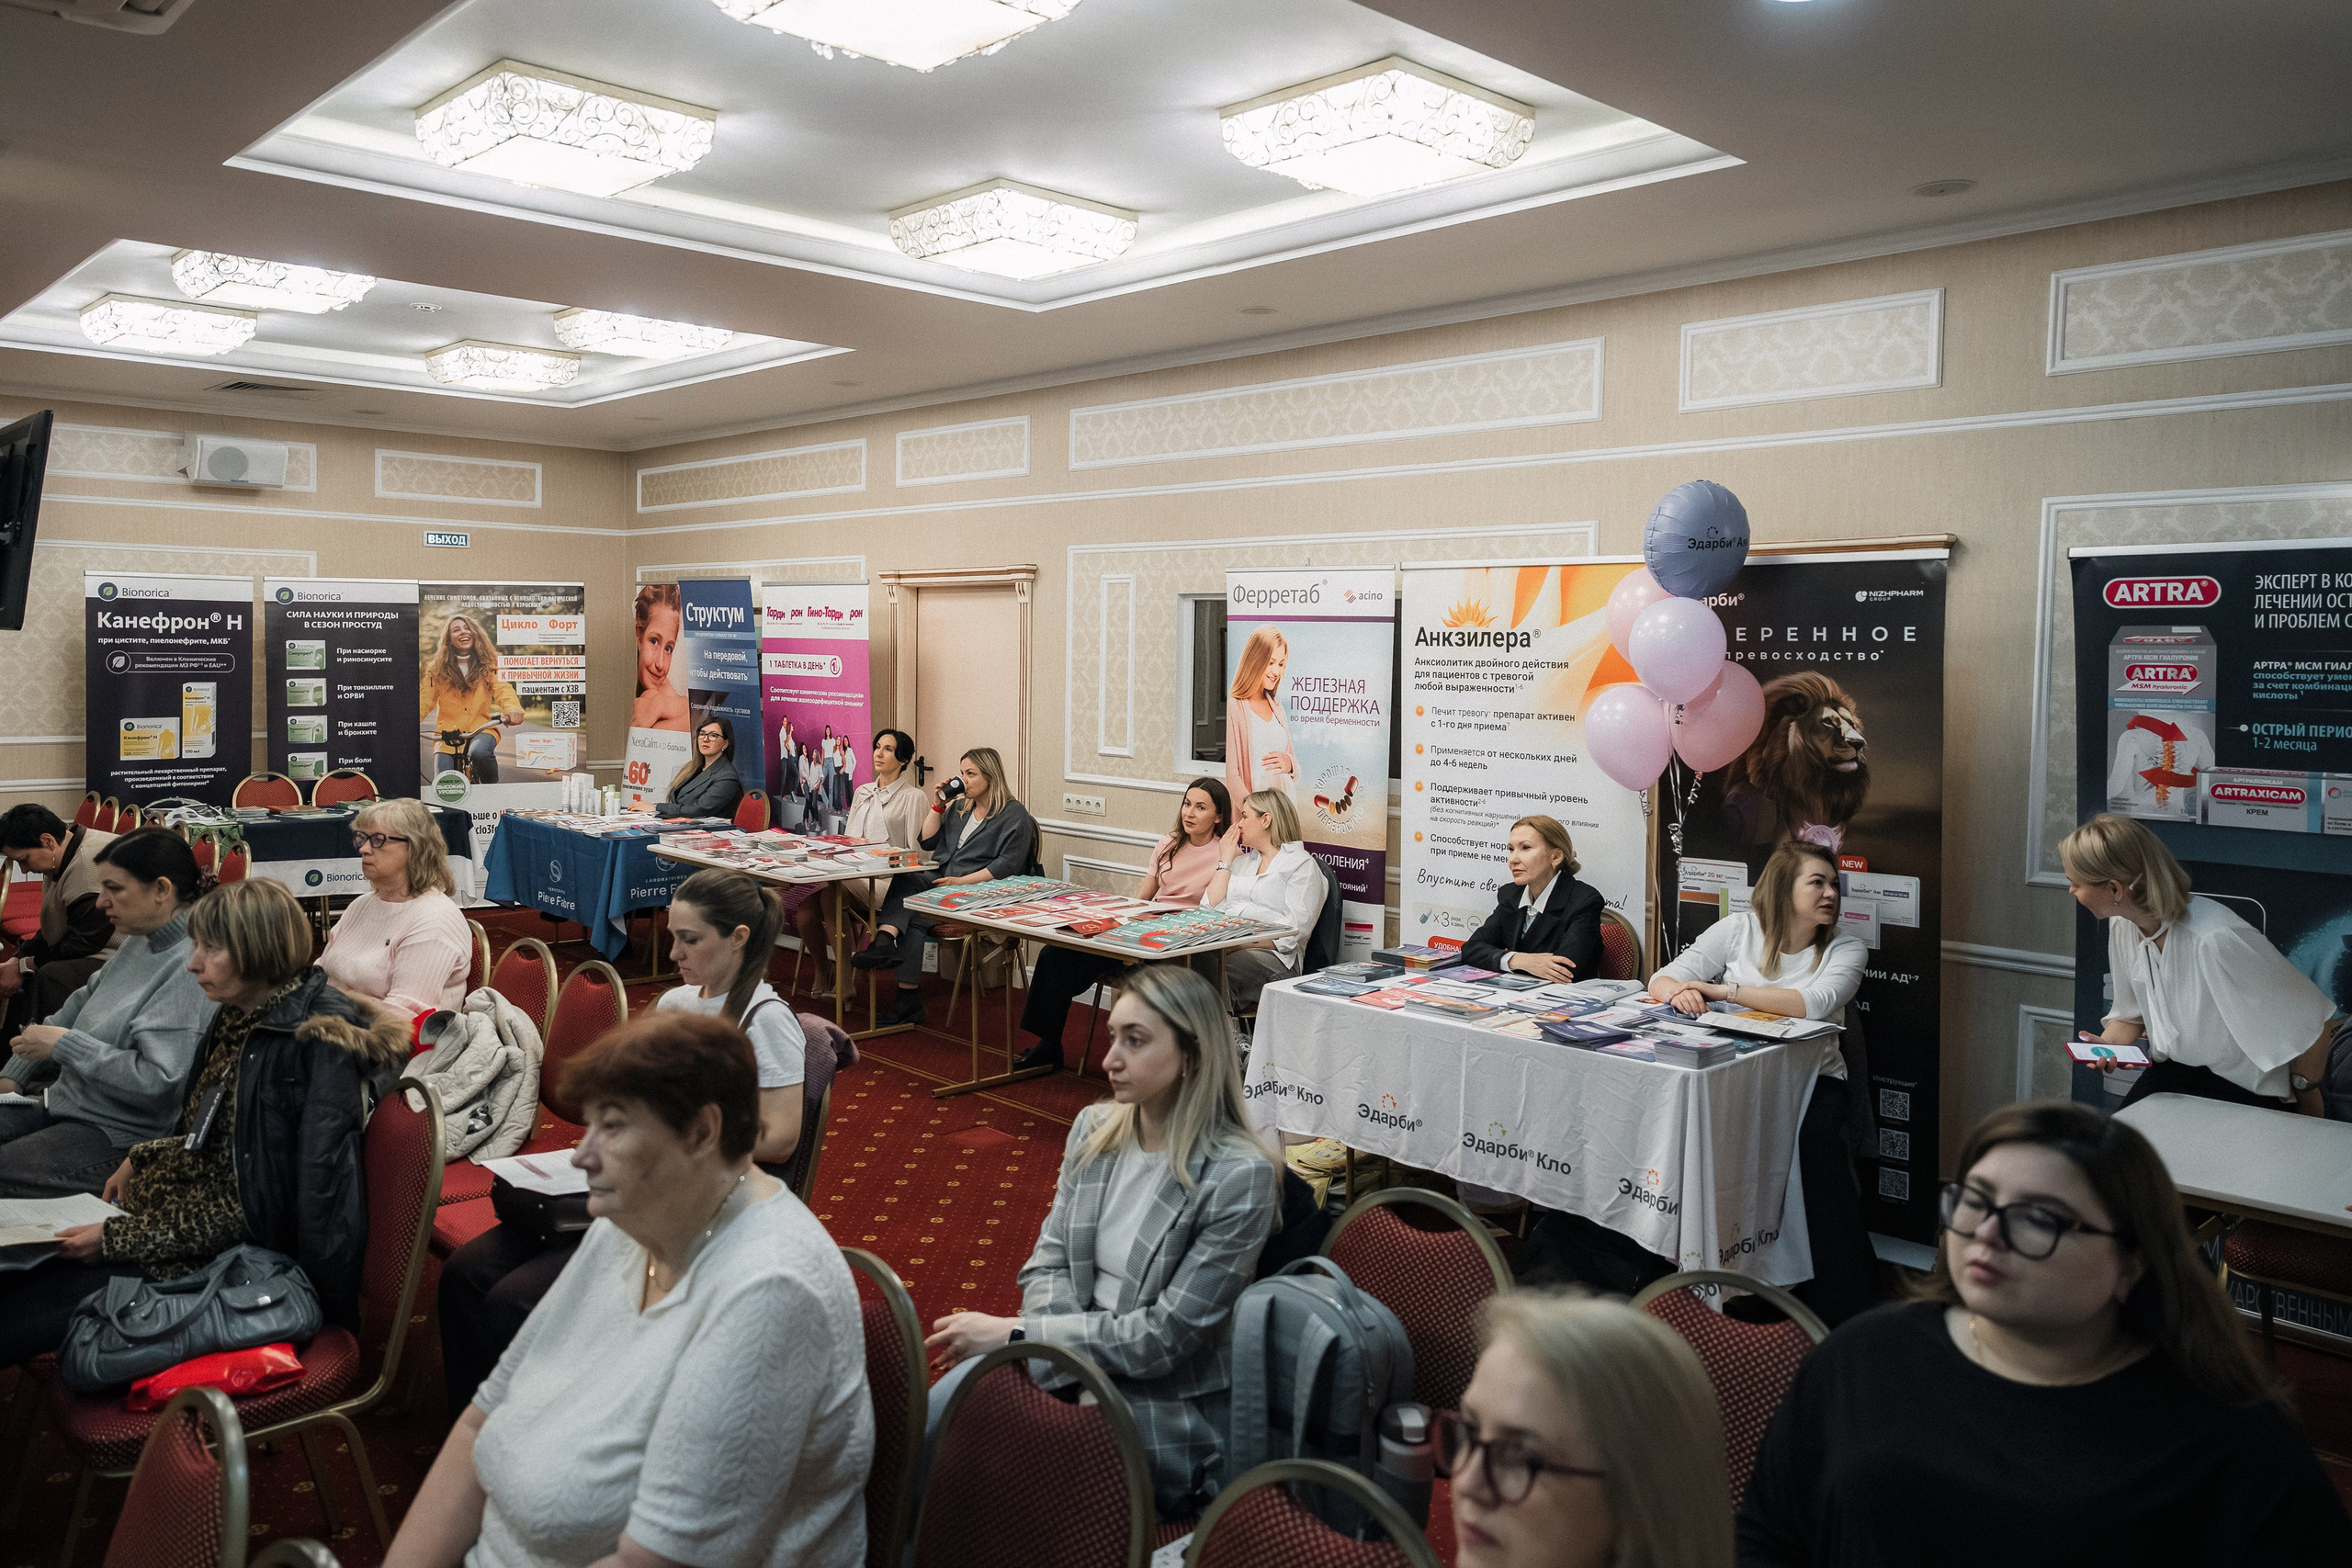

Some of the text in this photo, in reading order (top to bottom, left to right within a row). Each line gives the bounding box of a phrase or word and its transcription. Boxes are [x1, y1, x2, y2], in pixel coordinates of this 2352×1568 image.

[427, 534, 466, 546] ВЫХОД
[2255, 573, 2331, 590] ЭКСПЕРТ В
[1358, 591, 1383, 601] acino
[1869, 590, 1924, 599] NIZHPHARM
[2114, 580, 2209, 603] ARTRA®
[2254, 593, 2323, 609] ЛЕЧЕНИИ
[313, 611, 345, 619] НАУКИ
[354, 612, 399, 620] ПРИРОДЫ
[686, 603, 744, 628] Структум
[2255, 613, 2340, 628] И ПРОБЛЕМ
[97, 611, 243, 634] Канефрон® Н
[311, 621, 341, 629] СЕЗОН
[342, 621, 382, 629] ПРОСТУД
[502, 618, 578, 632] Цикло Форт
[150, 637, 209, 646] пиелонефрите,
[1414, 626, 1542, 653] Анкзилера®
[503, 657, 579, 666] ПОМОГАЕТ ВЕРНУТЬСЯ
[704, 649, 748, 662] На передовой,
[775, 660, 802, 669] ТАБЛЕТКА
[1414, 657, 1569, 671] Анксиолитик двойного действия
[2294, 661, 2323, 671] МСМ
[501, 670, 579, 680] К ПРИВЫЧНОЙ ЖИЗНИ
[690, 668, 708, 678] чтобы
[1414, 670, 1430, 680] для
[1431, 671, 1480, 682] пациентов
[1489, 671, 1534, 682] тревогой
[2253, 671, 2324, 682] способствует
[522, 684, 560, 695] пациентам
[1291, 676, 1365, 694] ЖЕЛЕЗНАЯ
[1414, 681, 1442, 692] любой
[1290, 695, 1380, 715] ПОДДЕРЖКА
[1431, 706, 1576, 722] Лечит препарат активен
[1300, 716, 1324, 724] время
[1325, 715, 1380, 727] беременности
[1437, 719, 1456, 728] 1-го
[1457, 721, 1473, 730] дня
[2252, 722, 2306, 738] ОСТРЫЙ
[632, 737, 687, 752] XeraCalm бальзам
[2253, 737, 2317, 751] 1-2 месяца
[1430, 745, 1486, 757] Применяется
[1499, 751, 1552, 761] нескольких
[1554, 753, 1577, 764] дней
[1430, 759, 1487, 771] до 4-6 недель
[110, 768, 154, 777] растительный
[153, 767, 199, 775] лекарственный
[1430, 783, 1589, 805] Поддерживает привычный уровень
[2214, 786, 2301, 801] ARTRAXICAM
[1430, 805, 1521, 821] (без когнитивных нарушений
[1430, 815, 1439, 823] на
[1440, 817, 1466, 827] скорость
[1571, 819, 1600, 829] влияния
[1430, 832, 1488, 850] Способствует
[1430, 847, 1492, 862] при приеме не
[1842, 859, 1863, 869] NEW
[645, 874, 688, 884] LABORATOIRES
[1417, 868, 1475, 889] Впустите
[630, 886, 667, 899] Pierre
[1296, 1086, 1324, 1105] Кло
[1357, 1103, 1423, 1132] Эдарби®
[1462, 1132, 1572, 1175] Эдарби® Кло
